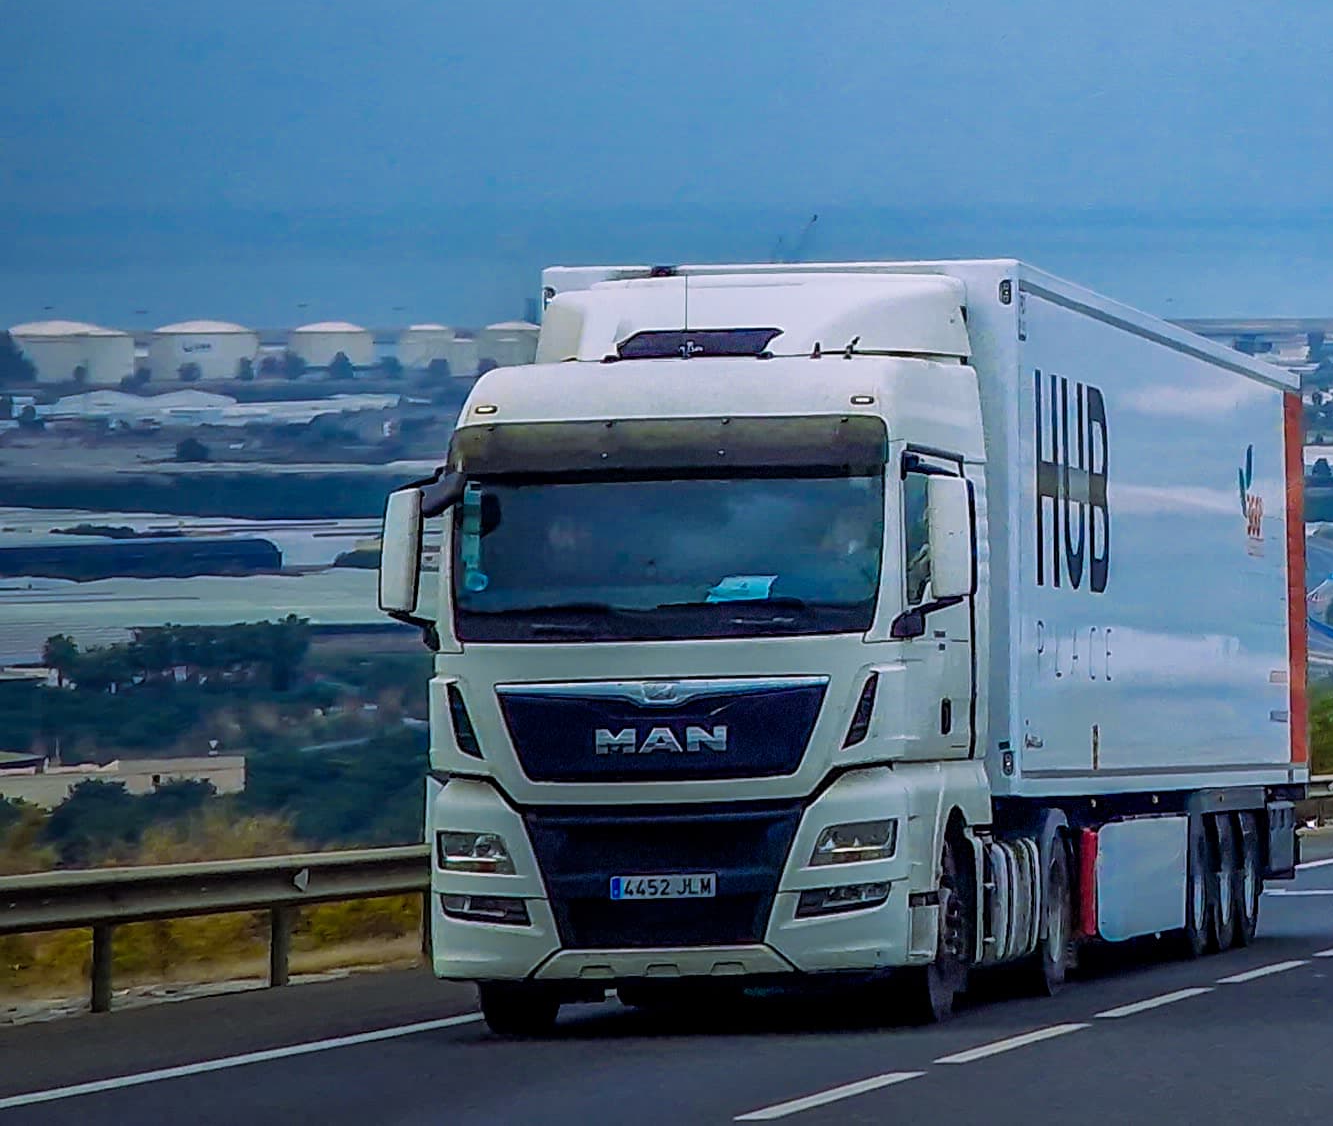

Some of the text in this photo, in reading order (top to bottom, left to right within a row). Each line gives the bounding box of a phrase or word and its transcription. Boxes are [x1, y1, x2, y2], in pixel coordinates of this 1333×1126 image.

[1034, 368, 1110, 594] HUB
[595, 724, 729, 754] MAN
[623, 877, 712, 896] 4452 JLM
